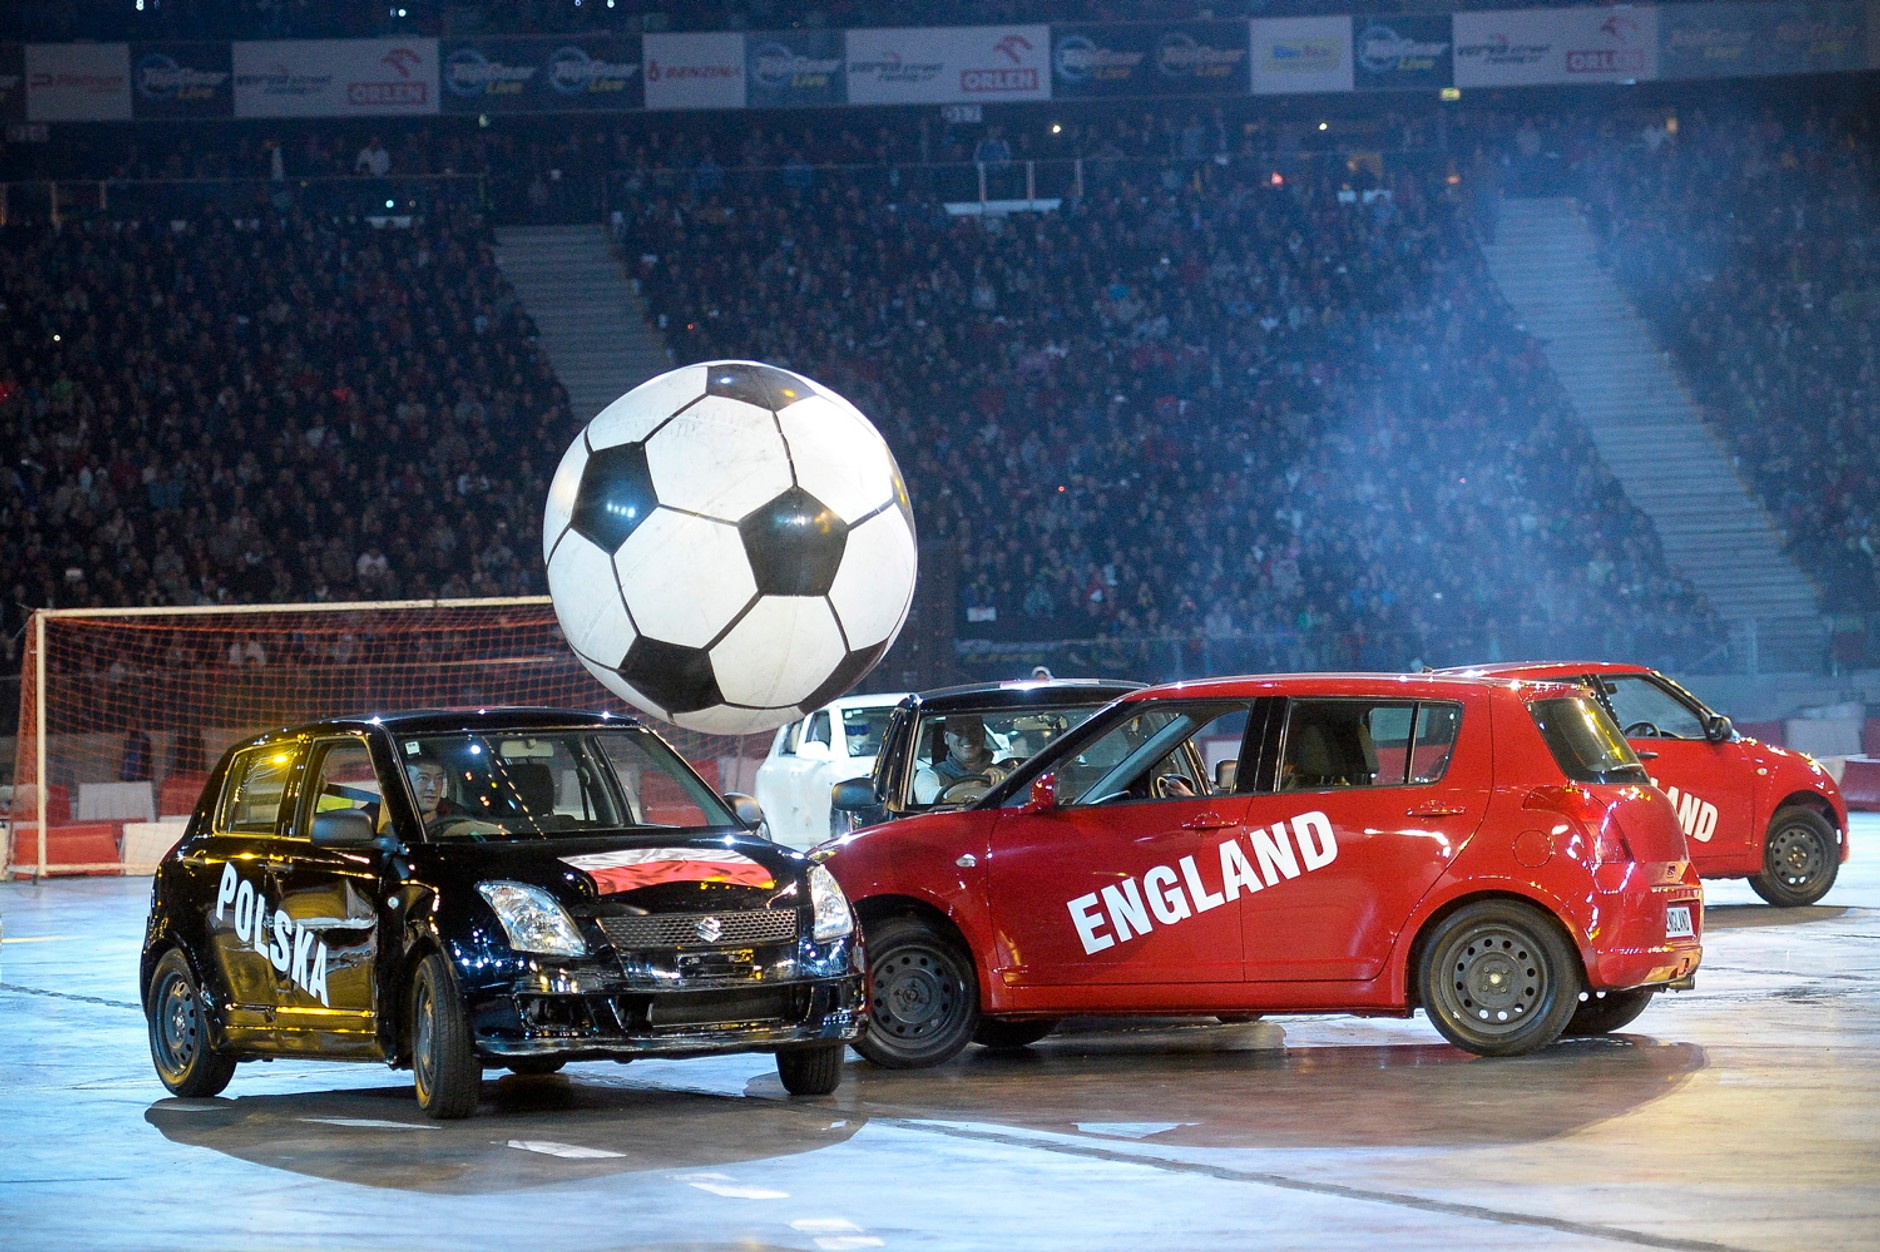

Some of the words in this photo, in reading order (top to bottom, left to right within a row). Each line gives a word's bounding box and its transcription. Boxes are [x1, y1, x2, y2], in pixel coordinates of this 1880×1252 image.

[352, 85, 422, 102] ORLEN
[964, 72, 1033, 88] ORLEN
[1066, 810, 1339, 955] ENGLAND
[216, 861, 329, 1008] POLSKA
